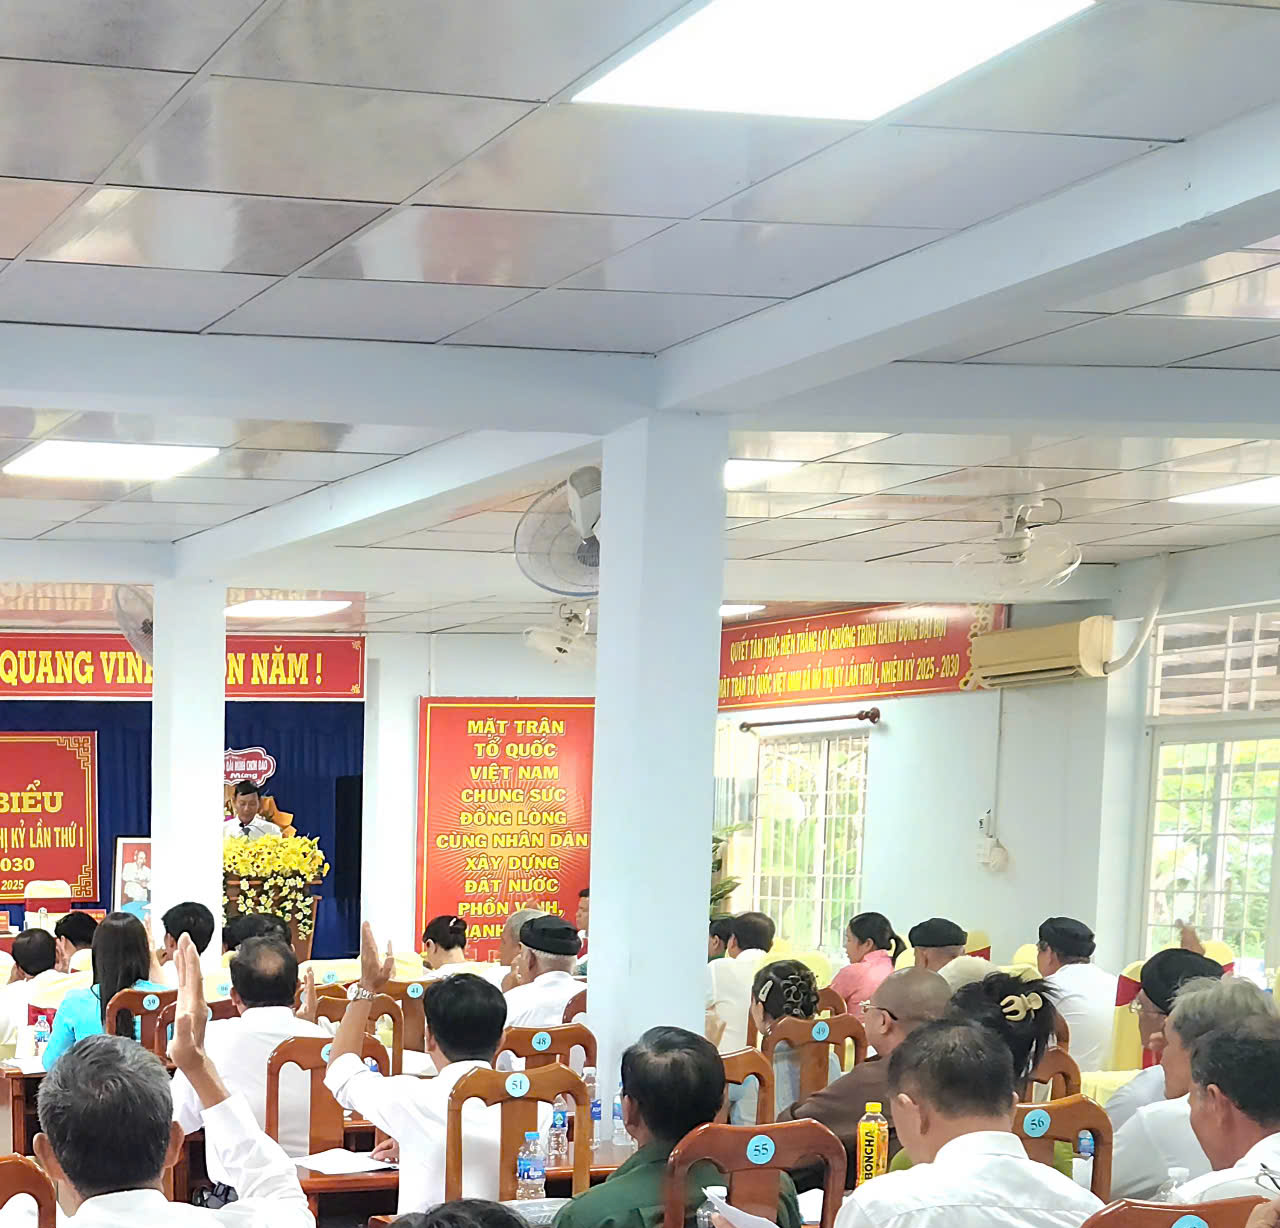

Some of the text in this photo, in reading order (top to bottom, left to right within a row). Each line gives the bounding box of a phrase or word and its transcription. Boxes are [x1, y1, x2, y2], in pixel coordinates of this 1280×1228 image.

[251, 645, 308, 685] NĂM
[917, 657, 934, 680] 2025
[940, 654, 960, 677] 2030
[467, 716, 565, 738] MẶT TRẬN
[474, 737, 557, 759] TỔ QUỐC
[470, 763, 559, 783] VIỆT NAM
[461, 786, 567, 803] CHUNG SỨC
[460, 807, 567, 825] ĐỒNG LÒNG
[11, 818, 26, 848] KỶ
[29, 818, 51, 848] LẦN
[54, 821, 78, 847] THỨ
[79, 827, 84, 848] I
[436, 830, 588, 849] CÙNG NHÂN DÂN
[465, 854, 560, 873] XÂY DỰNG
[1, 880, 24, 891] 2025
[465, 874, 559, 893] ĐẤT NƯỚC
[458, 897, 509, 916] PHỒN
[511, 1080, 522, 1090] 51
[1030, 1118, 1044, 1129] 56
[754, 1143, 768, 1154] 55
